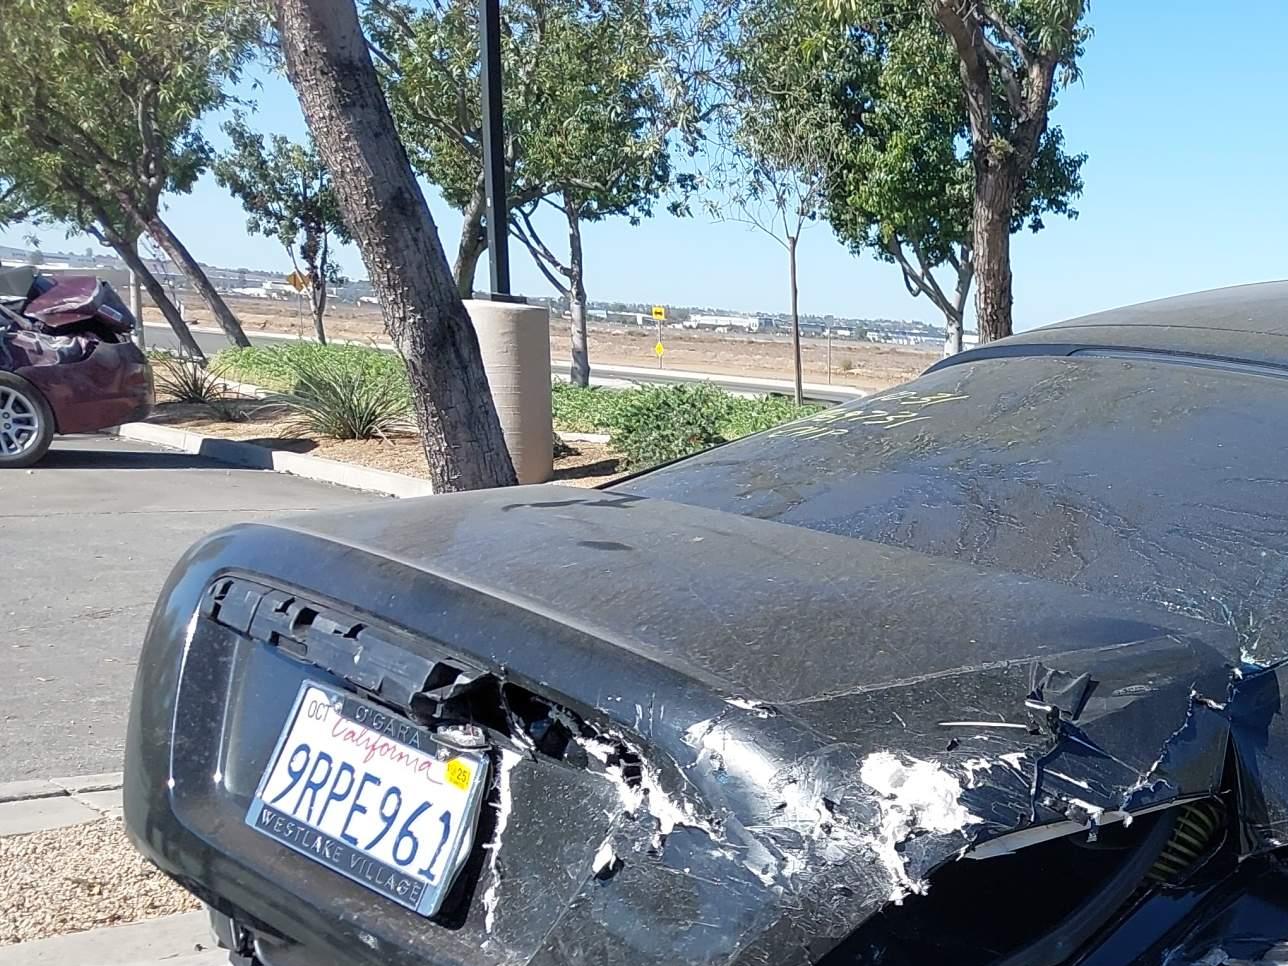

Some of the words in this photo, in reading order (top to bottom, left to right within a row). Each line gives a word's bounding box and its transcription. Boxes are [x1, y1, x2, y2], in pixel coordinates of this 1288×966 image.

[307, 699, 330, 720] OCT
[355, 704, 421, 747] O'GARA
[330, 716, 443, 785] California
[270, 742, 452, 882] 9RPE961
[261, 808, 343, 863] WESTLAKE
[348, 857, 426, 904] VILLAGE
